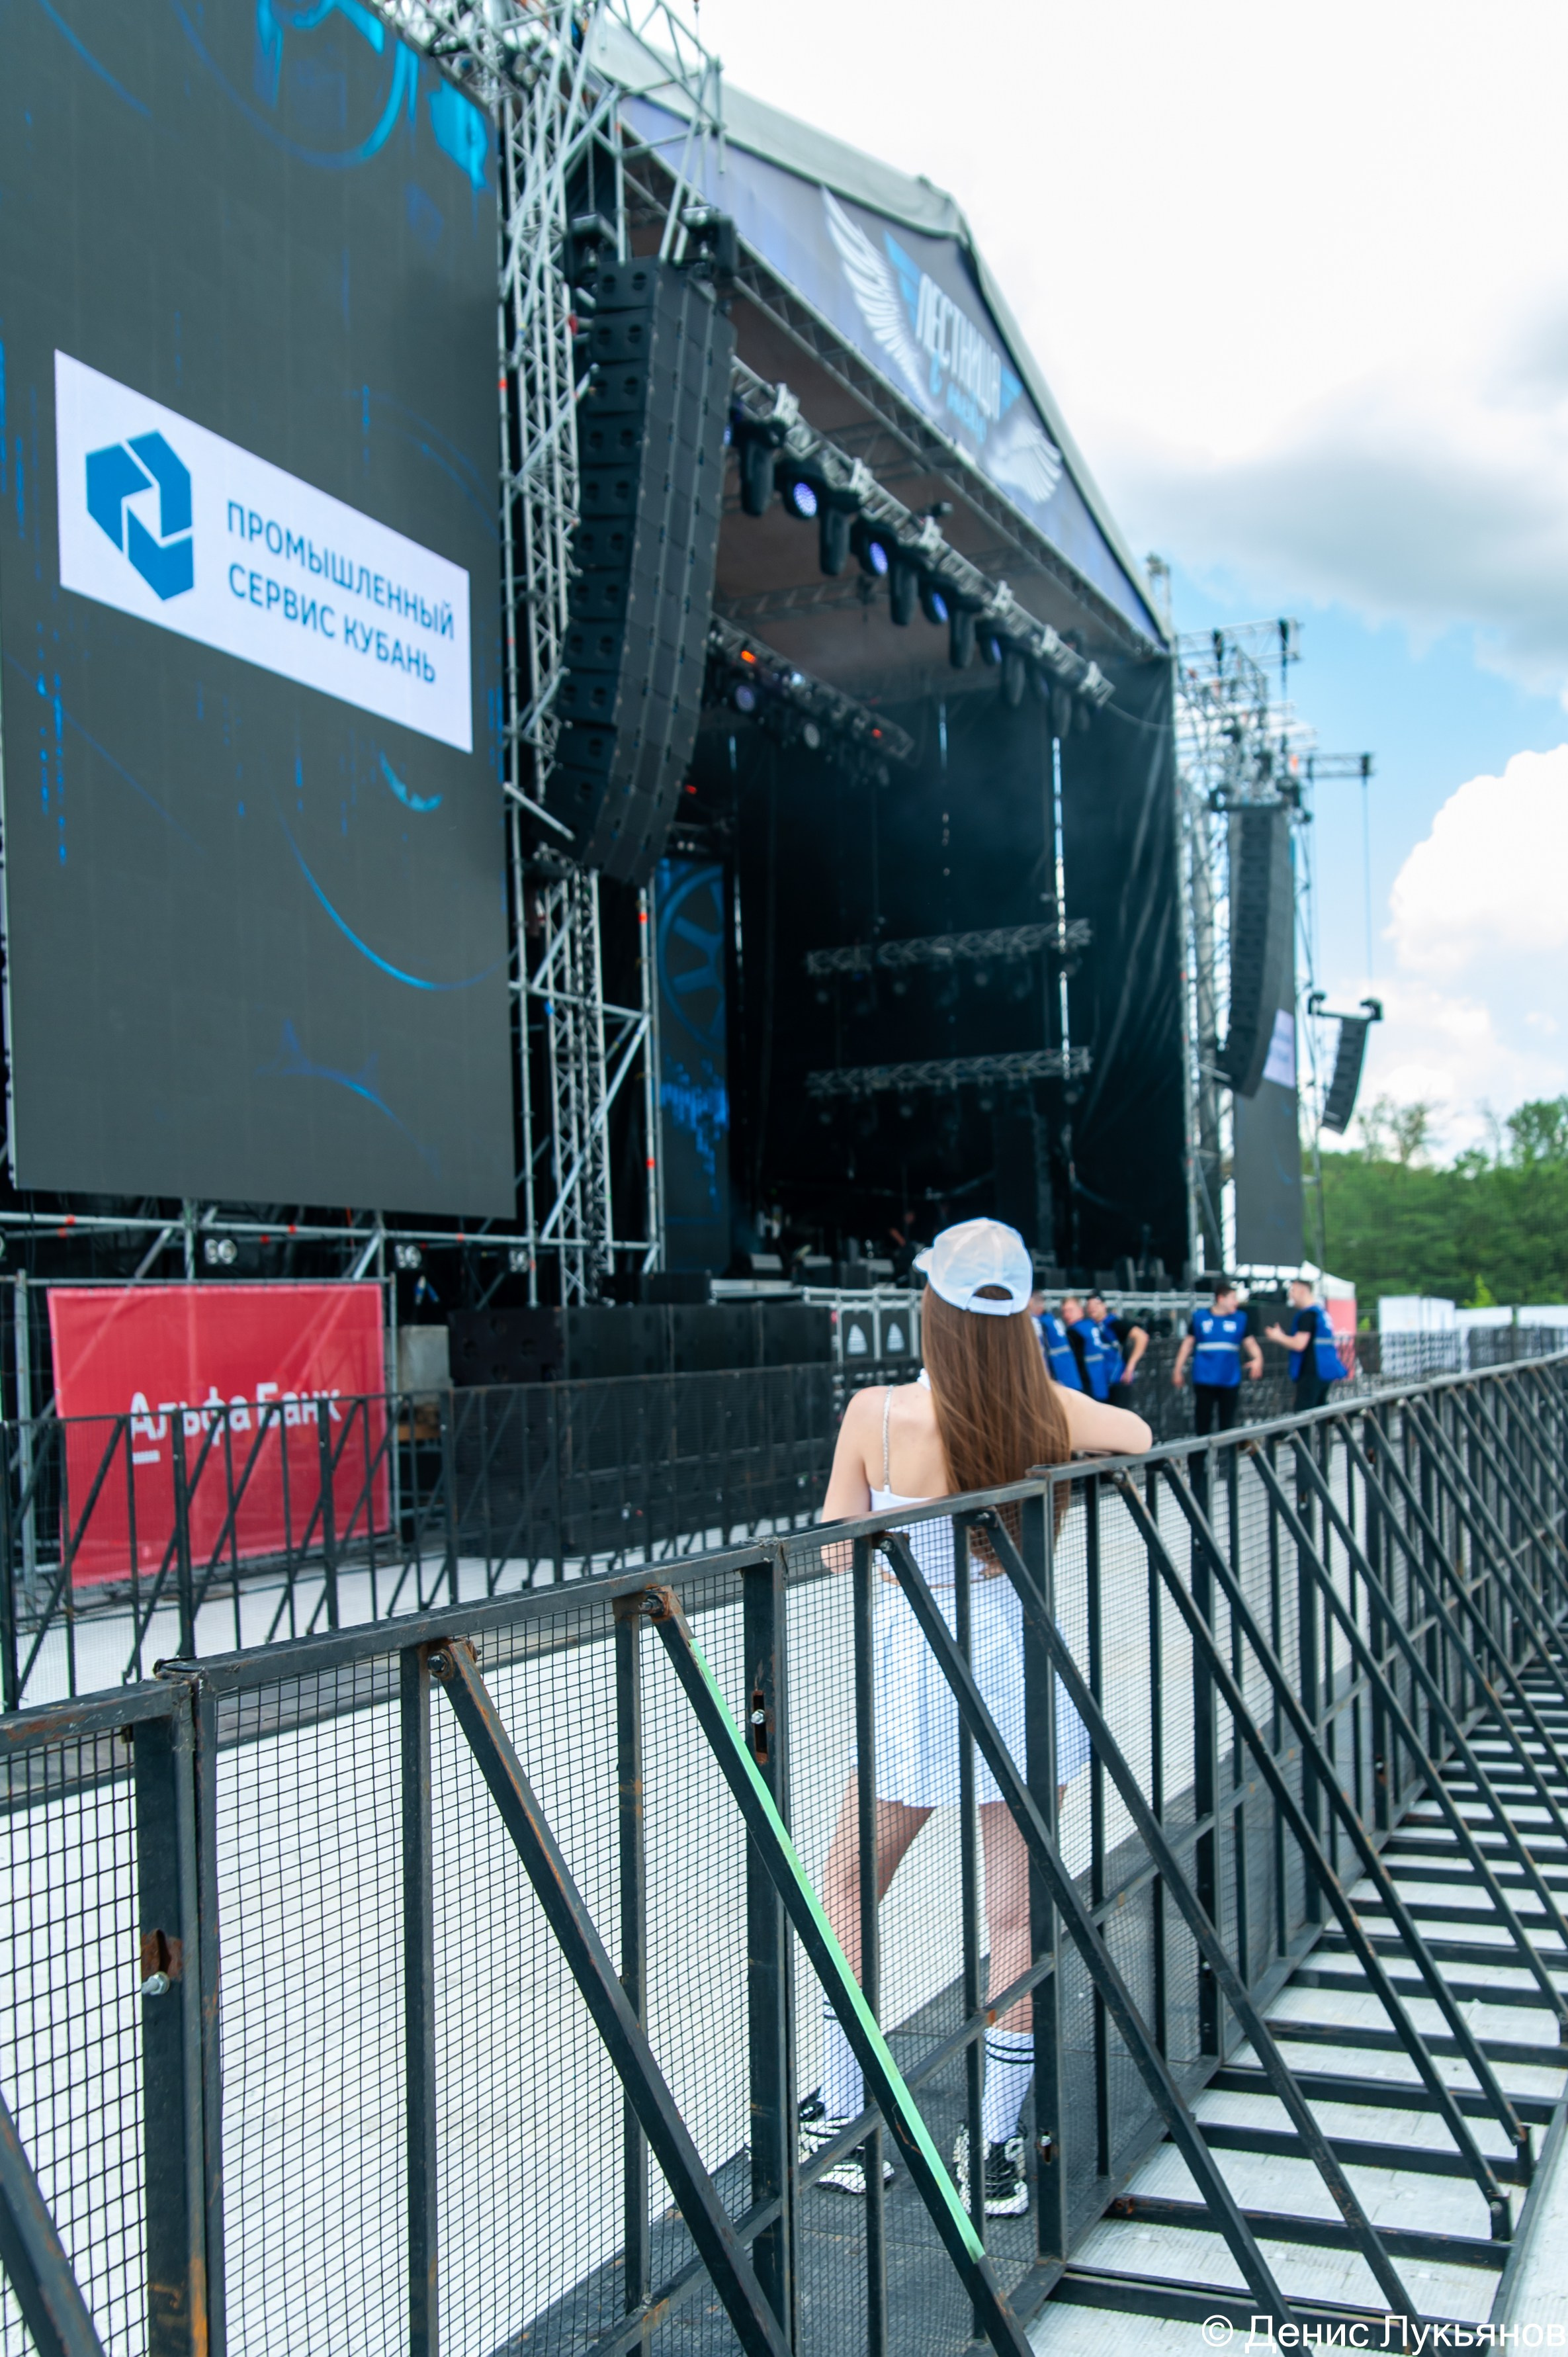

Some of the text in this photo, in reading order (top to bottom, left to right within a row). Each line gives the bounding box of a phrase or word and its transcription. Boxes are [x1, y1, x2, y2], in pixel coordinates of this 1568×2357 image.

[228, 500, 455, 641] ПРОМЫШЛЕННЫЙ
[229, 562, 437, 684] СЕРВИС КУБАНЬ
